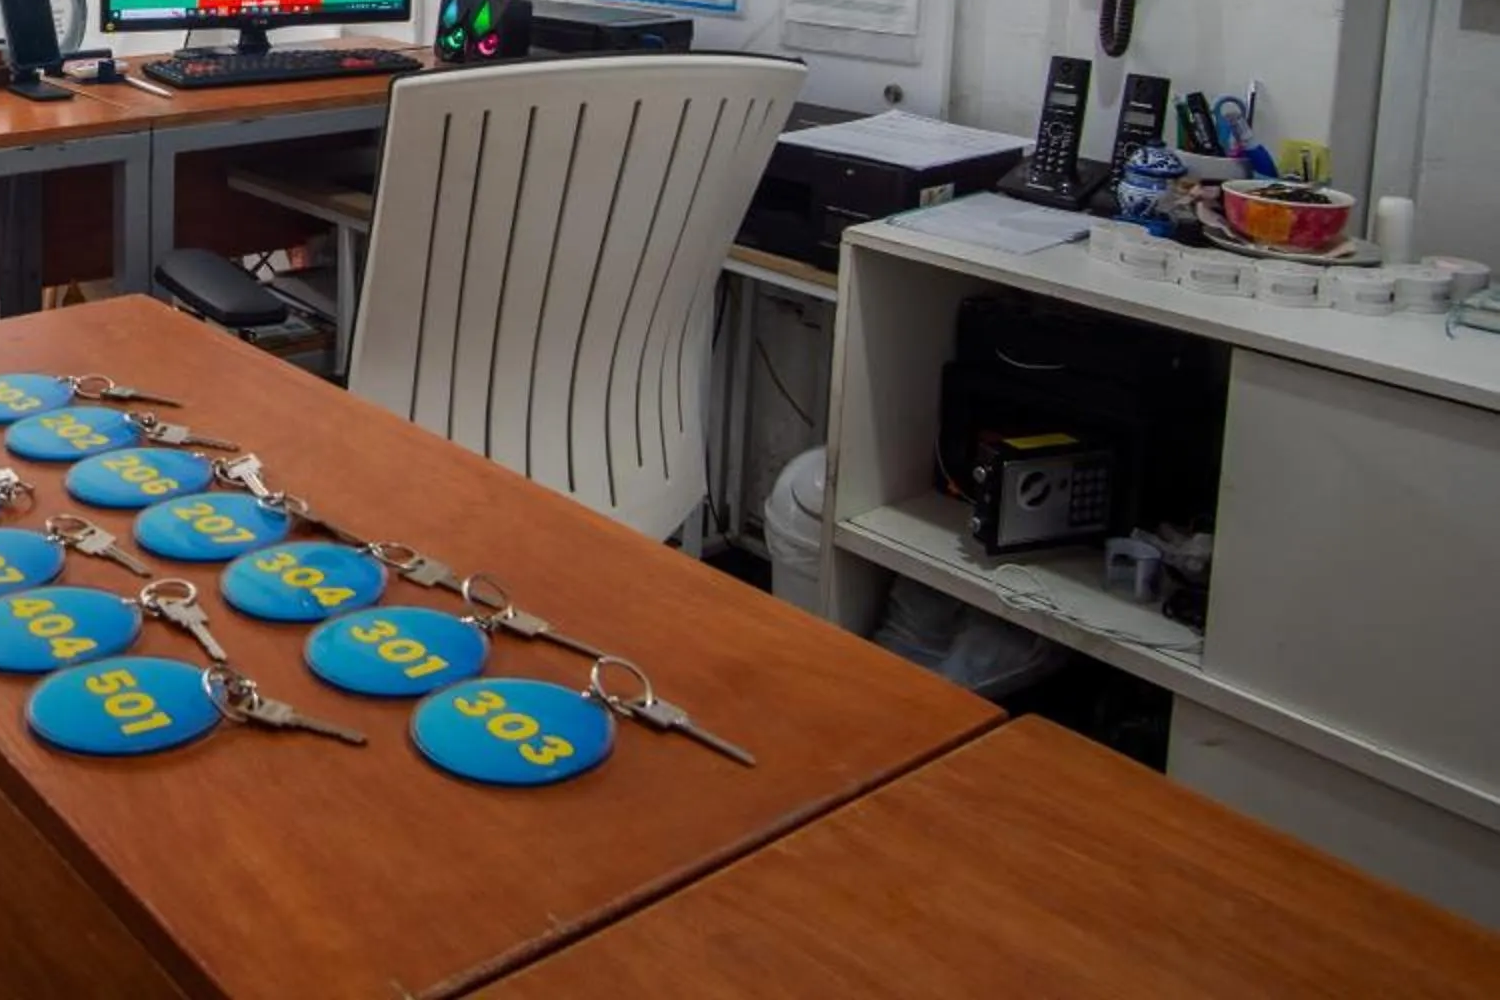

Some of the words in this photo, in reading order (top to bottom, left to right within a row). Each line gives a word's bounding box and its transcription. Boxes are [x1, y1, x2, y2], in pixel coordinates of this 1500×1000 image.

[38, 413, 110, 450] 202
[102, 454, 180, 496] 206
[172, 501, 256, 544] 207
[255, 552, 356, 607] 304
[10, 597, 98, 658] 404
[350, 619, 449, 679] 301
[85, 669, 173, 735] 501
[453, 690, 575, 766] 303
